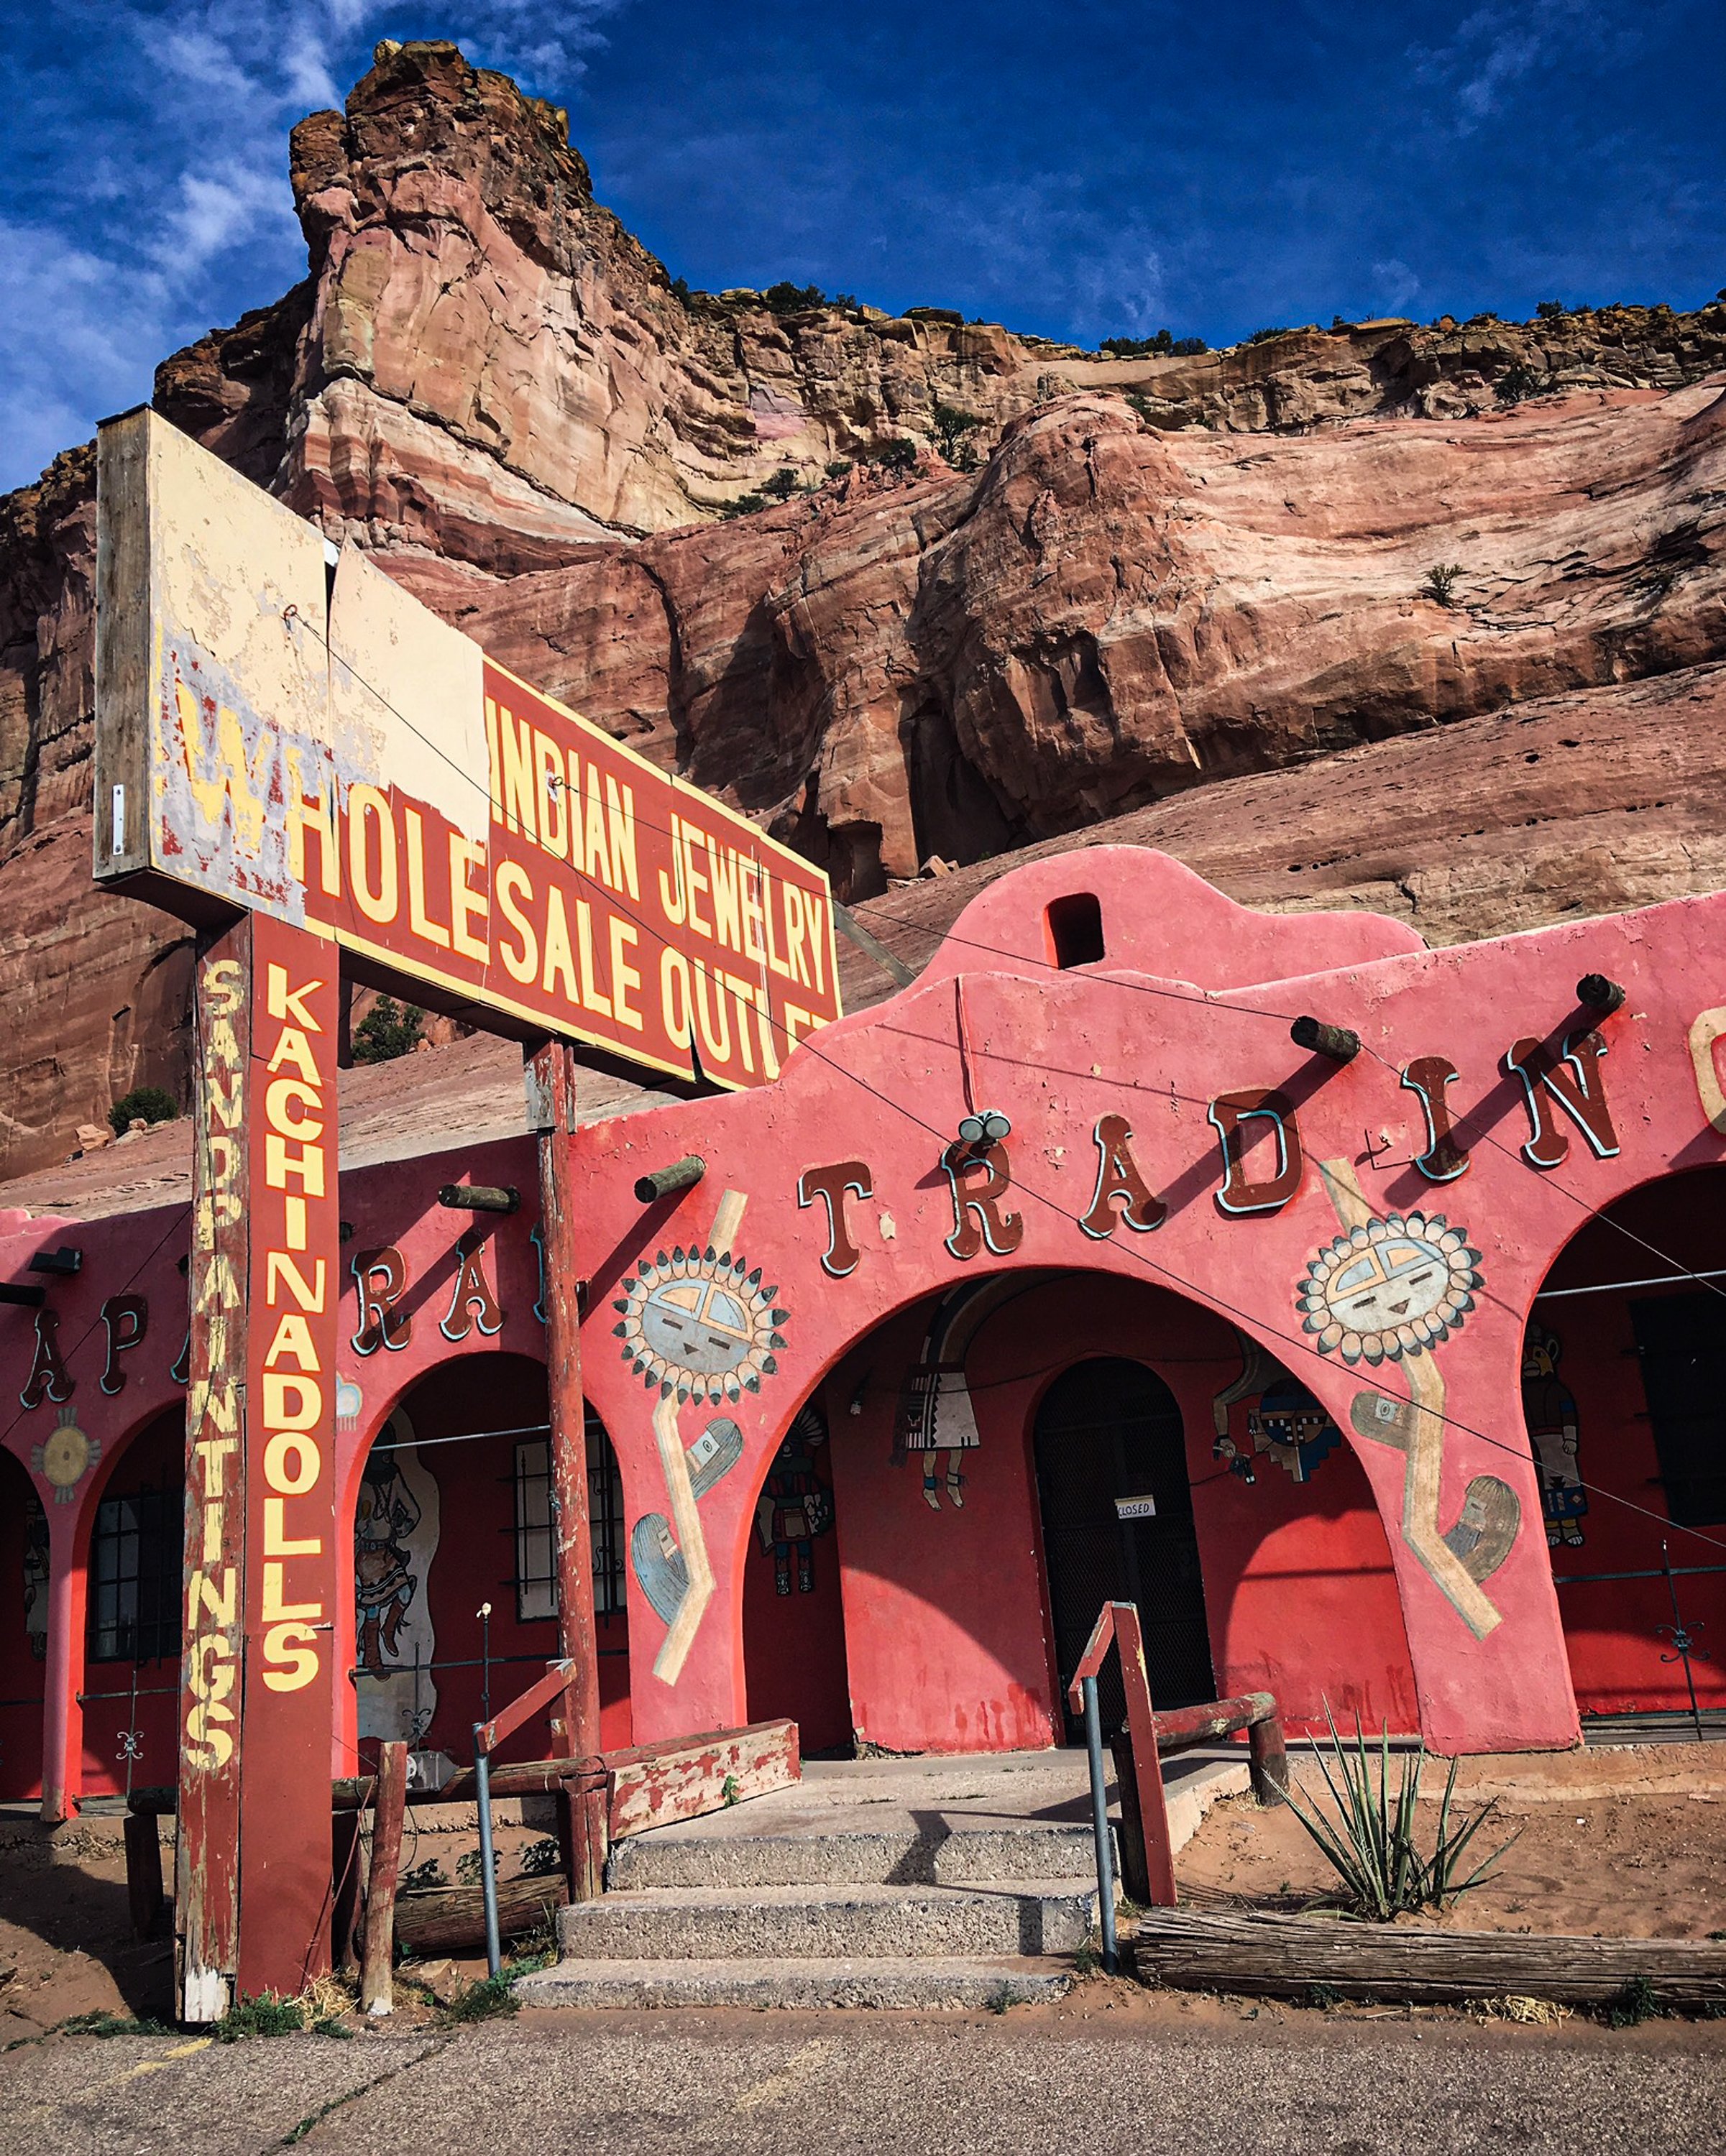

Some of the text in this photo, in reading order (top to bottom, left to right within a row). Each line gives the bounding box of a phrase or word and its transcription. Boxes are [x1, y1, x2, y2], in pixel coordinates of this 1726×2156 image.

[175, 677, 644, 1032] WHOLESALE
[485, 697, 825, 996] INDIAN JEWELRY
[1119, 1503, 1150, 1517] CLOSED
